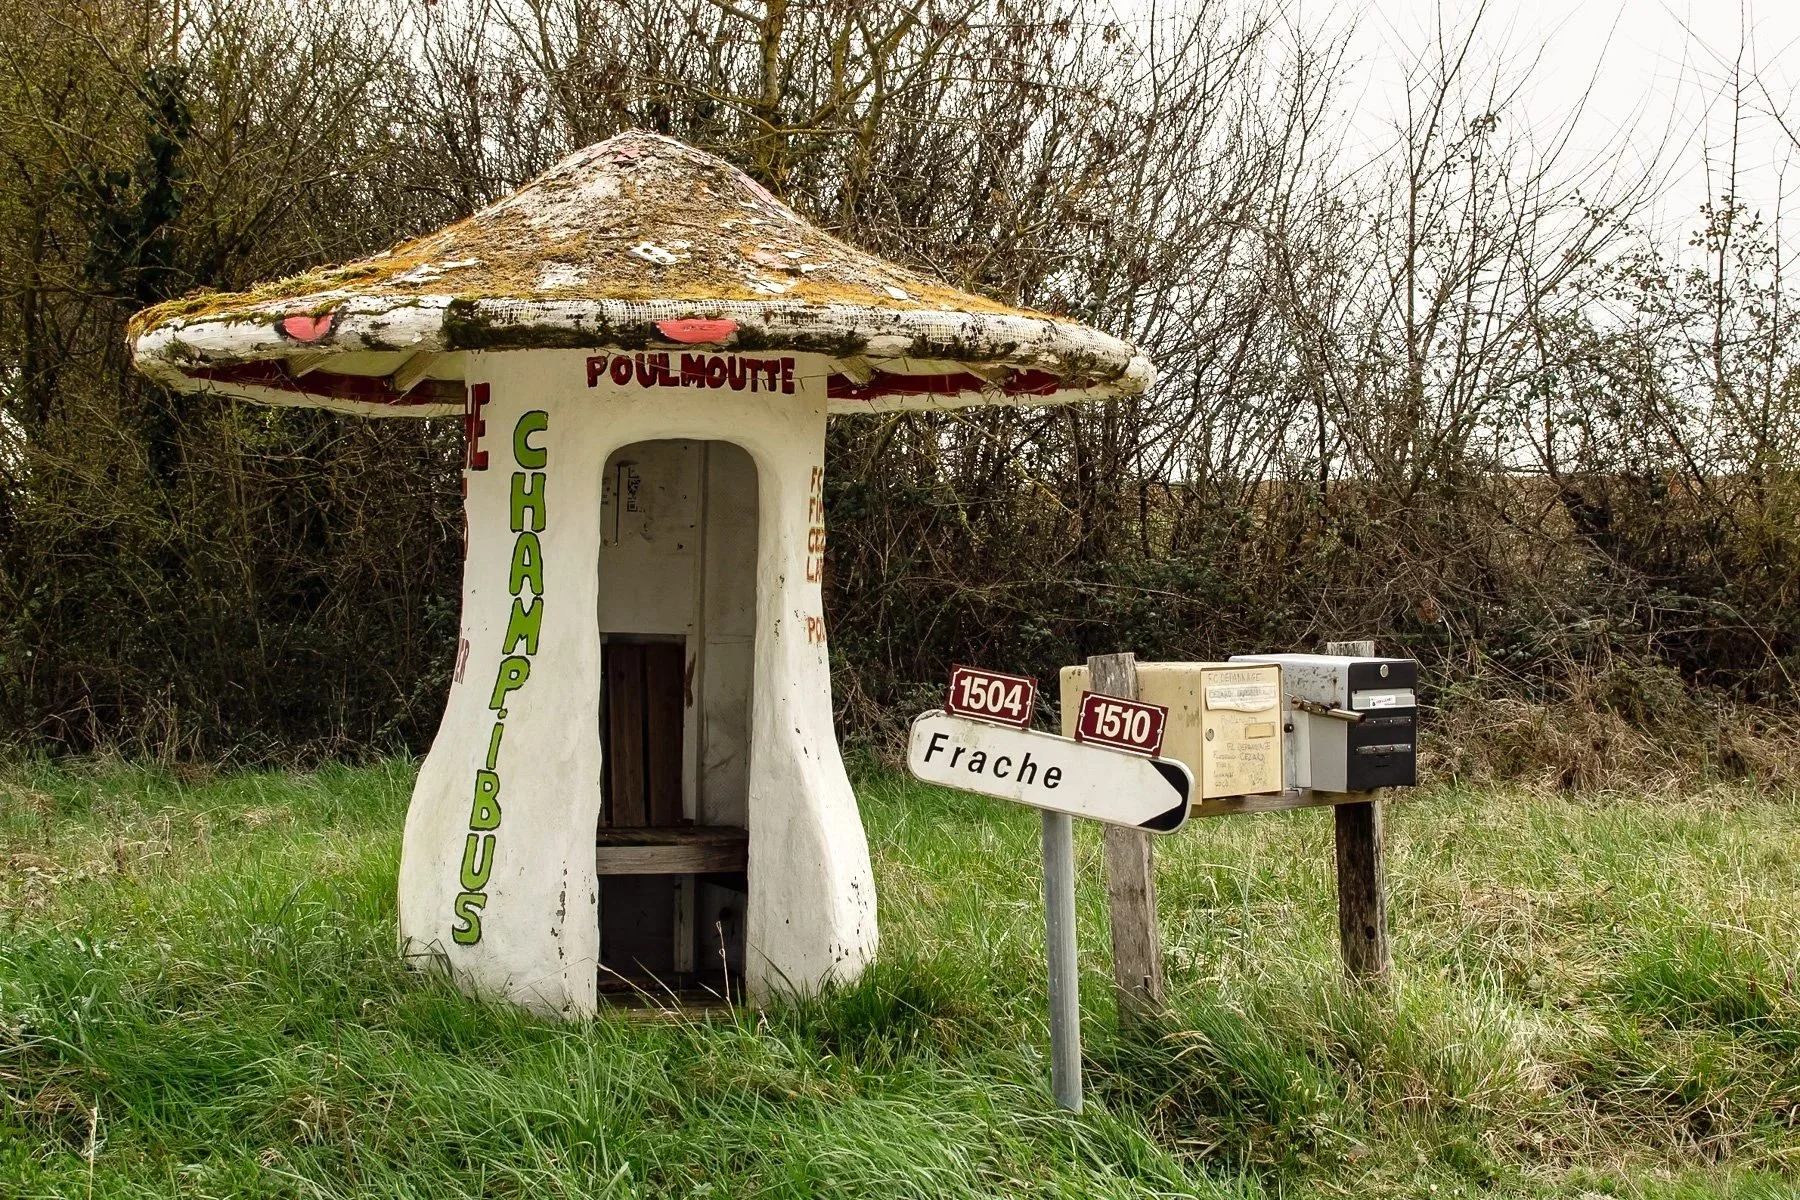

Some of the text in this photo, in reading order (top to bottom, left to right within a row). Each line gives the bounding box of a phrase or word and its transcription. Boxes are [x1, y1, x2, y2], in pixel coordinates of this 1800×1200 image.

[586, 352, 796, 395] POULMOUTTE
[960, 675, 1023, 717] 1504
[1093, 703, 1152, 744] 1510
[923, 731, 1063, 790] Frache
